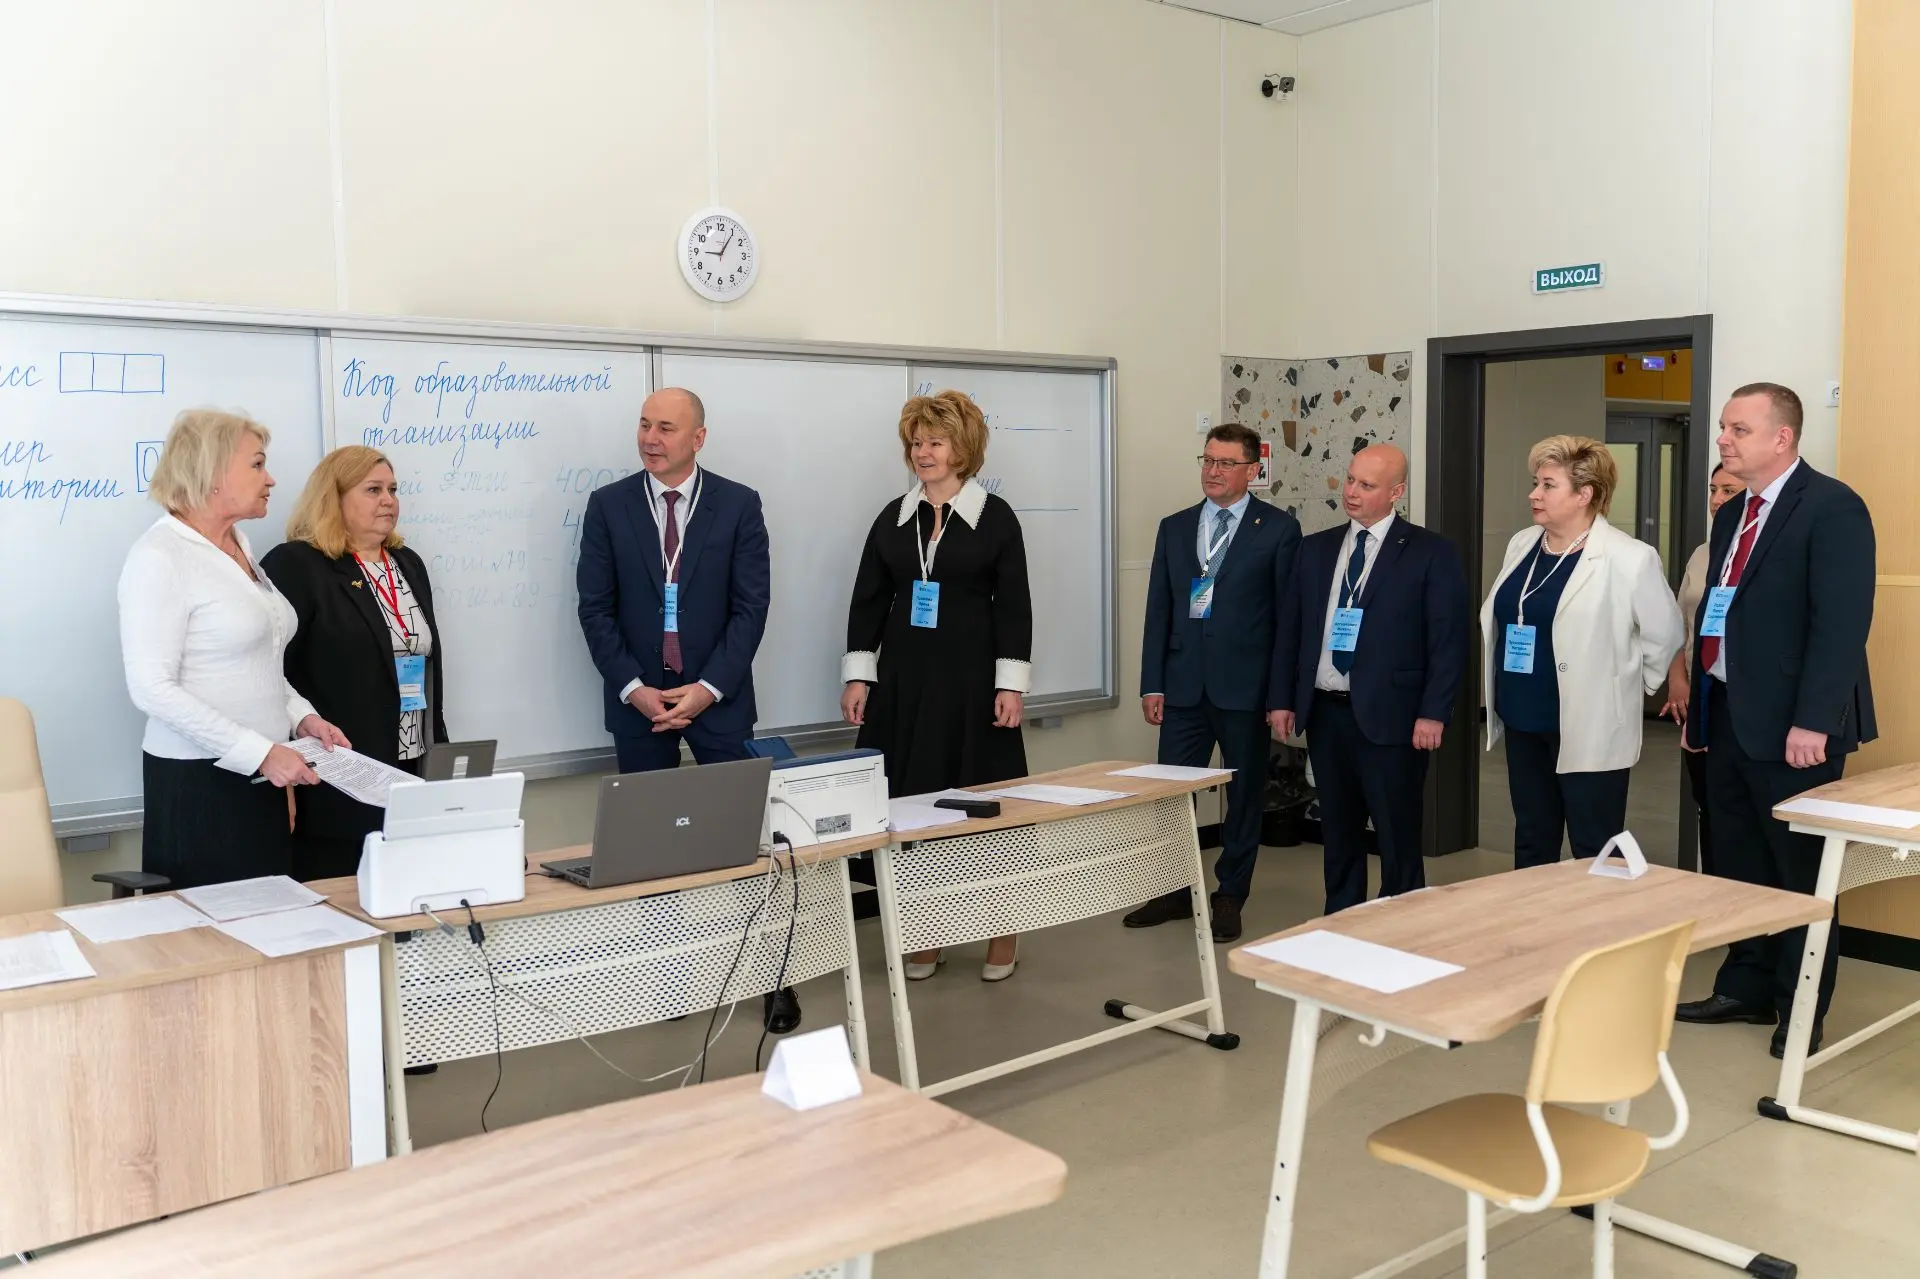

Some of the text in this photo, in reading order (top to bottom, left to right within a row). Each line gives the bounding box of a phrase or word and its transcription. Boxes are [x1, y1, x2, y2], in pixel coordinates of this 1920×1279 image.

[716, 223, 725, 231] 12
[698, 234, 706, 243] 10
[738, 239, 743, 247] 2
[694, 247, 699, 256] 9
[741, 252, 747, 260] 3
[698, 261, 703, 270] 8
[706, 272, 712, 280] 7
[730, 274, 735, 282] 5
[1540, 267, 1598, 287] ВЫХОД
[717, 277, 723, 285] 6
[0, 365, 42, 388] сс
[343, 357, 613, 424] Код образовательной
[362, 420, 540, 469] организации
[0, 477, 124, 525] итории
